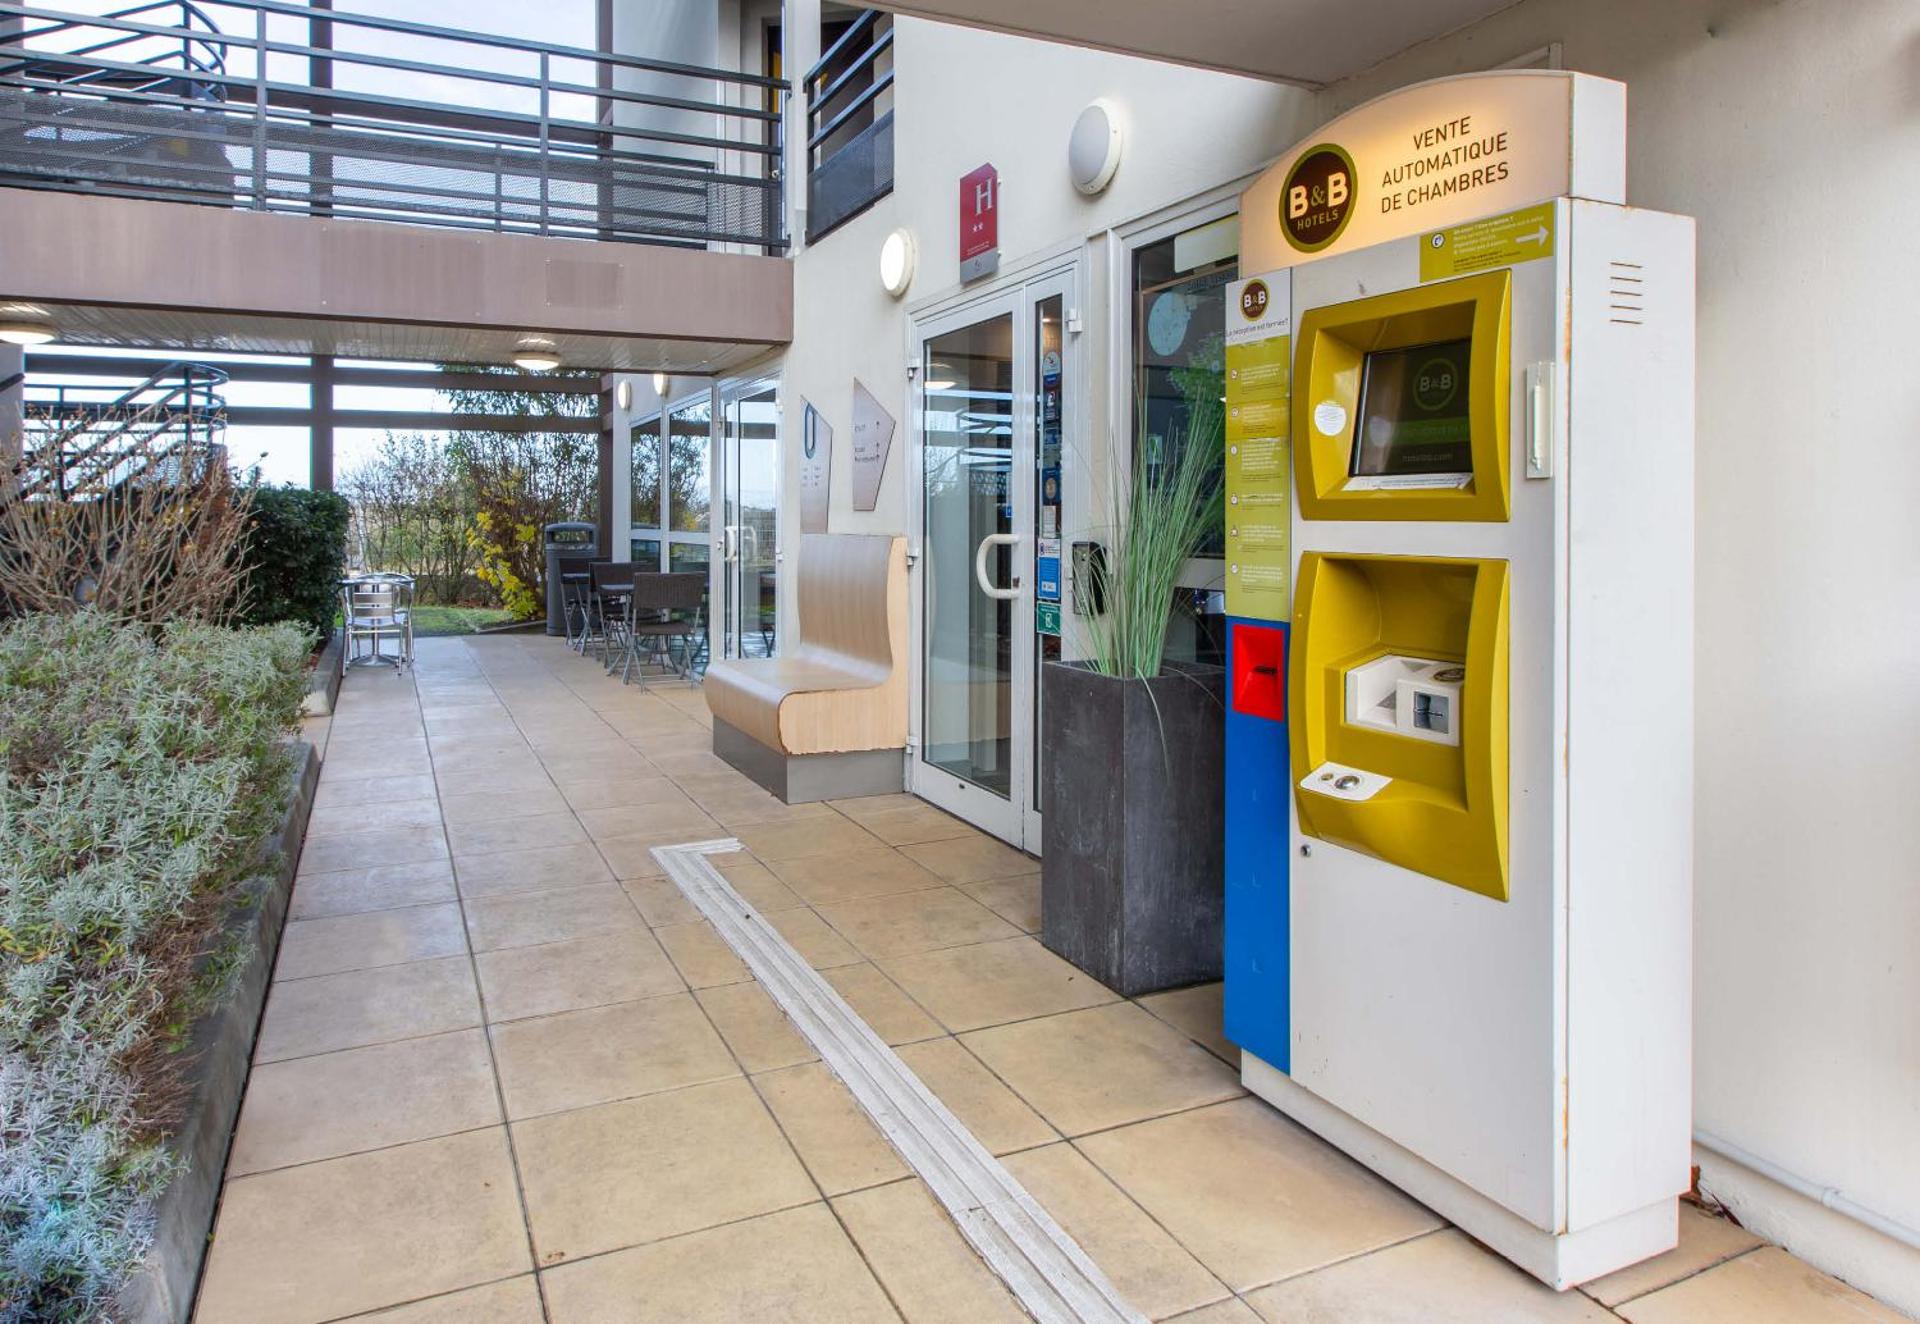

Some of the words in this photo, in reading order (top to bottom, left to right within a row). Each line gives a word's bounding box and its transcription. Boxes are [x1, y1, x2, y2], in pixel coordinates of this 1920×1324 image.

[1413, 116, 1471, 150] VENTE
[1382, 132, 1508, 187] AUTOMATIQUE
[976, 178, 993, 215] H
[1289, 172, 1348, 219] B&B
[1381, 193, 1402, 213] DE
[1407, 161, 1509, 205] CHAMBRES
[1297, 209, 1339, 230] HOTELS
